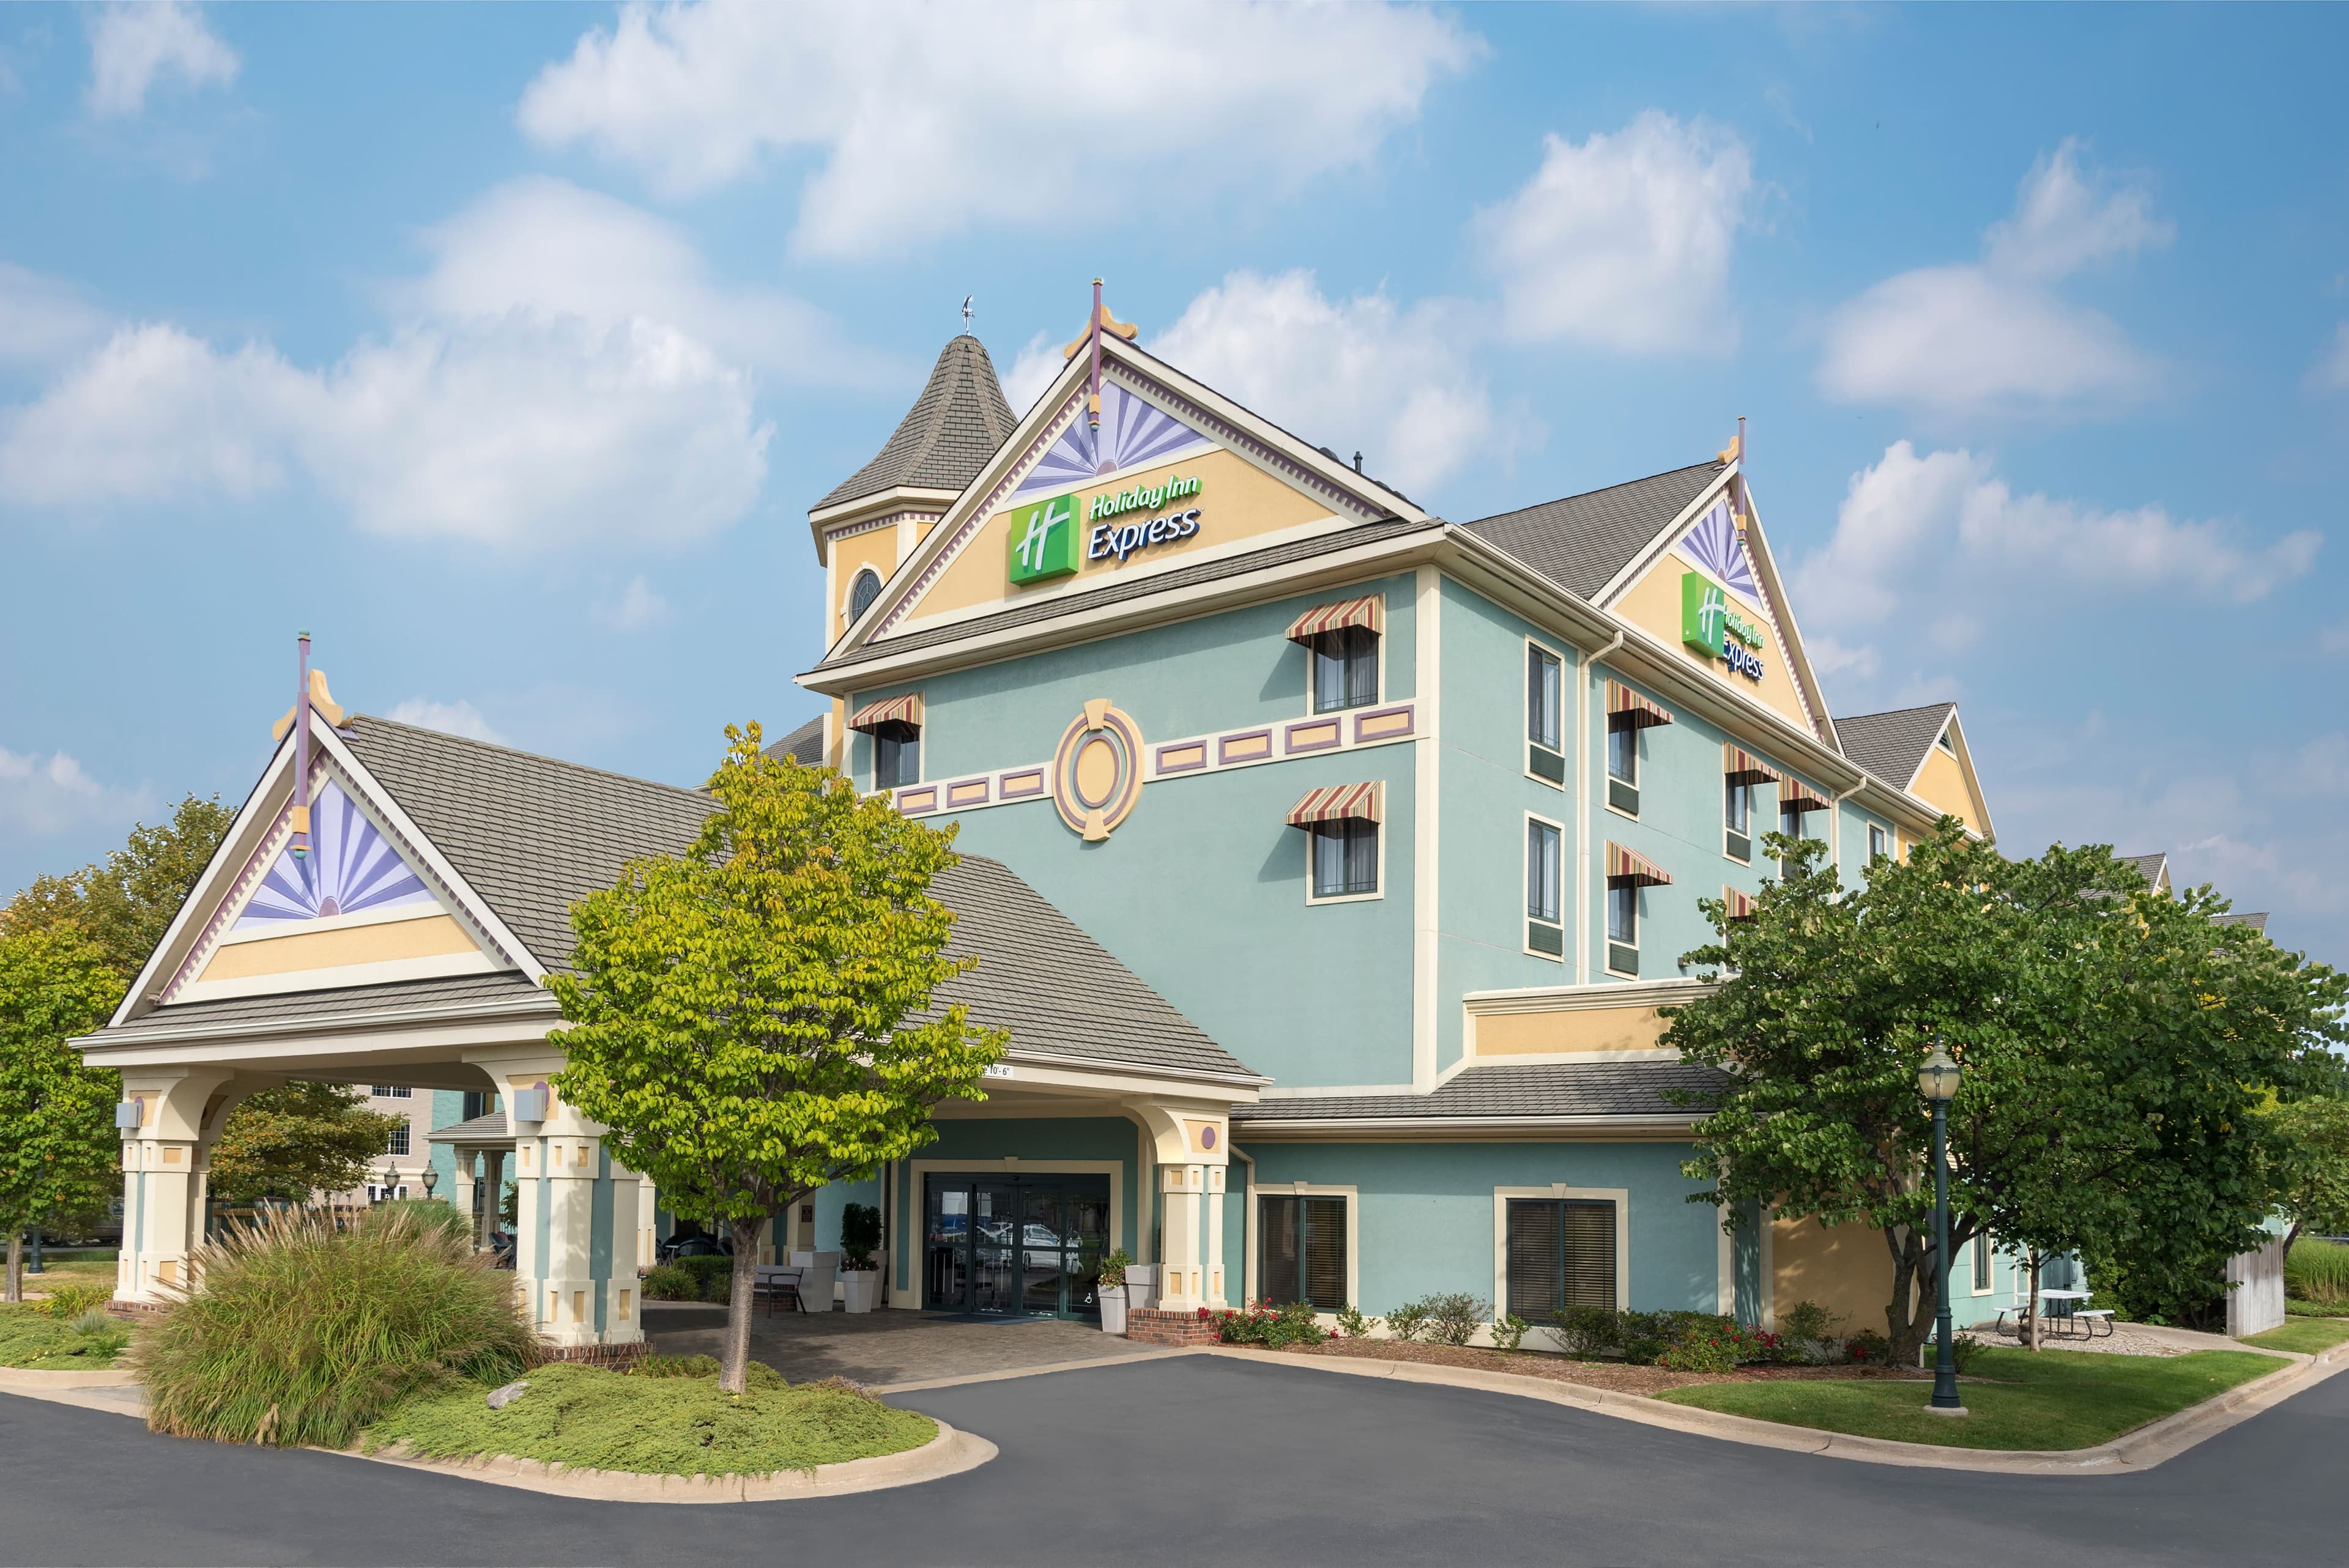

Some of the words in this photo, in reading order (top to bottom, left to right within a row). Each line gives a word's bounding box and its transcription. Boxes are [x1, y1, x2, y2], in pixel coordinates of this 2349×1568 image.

[1089, 484, 1165, 521] Holiday
[1165, 474, 1201, 500] Inn
[1087, 508, 1200, 561] Express
[1724, 605, 1753, 644] Holiday
[1752, 624, 1765, 648] Inn
[1723, 630, 1765, 680] Express
